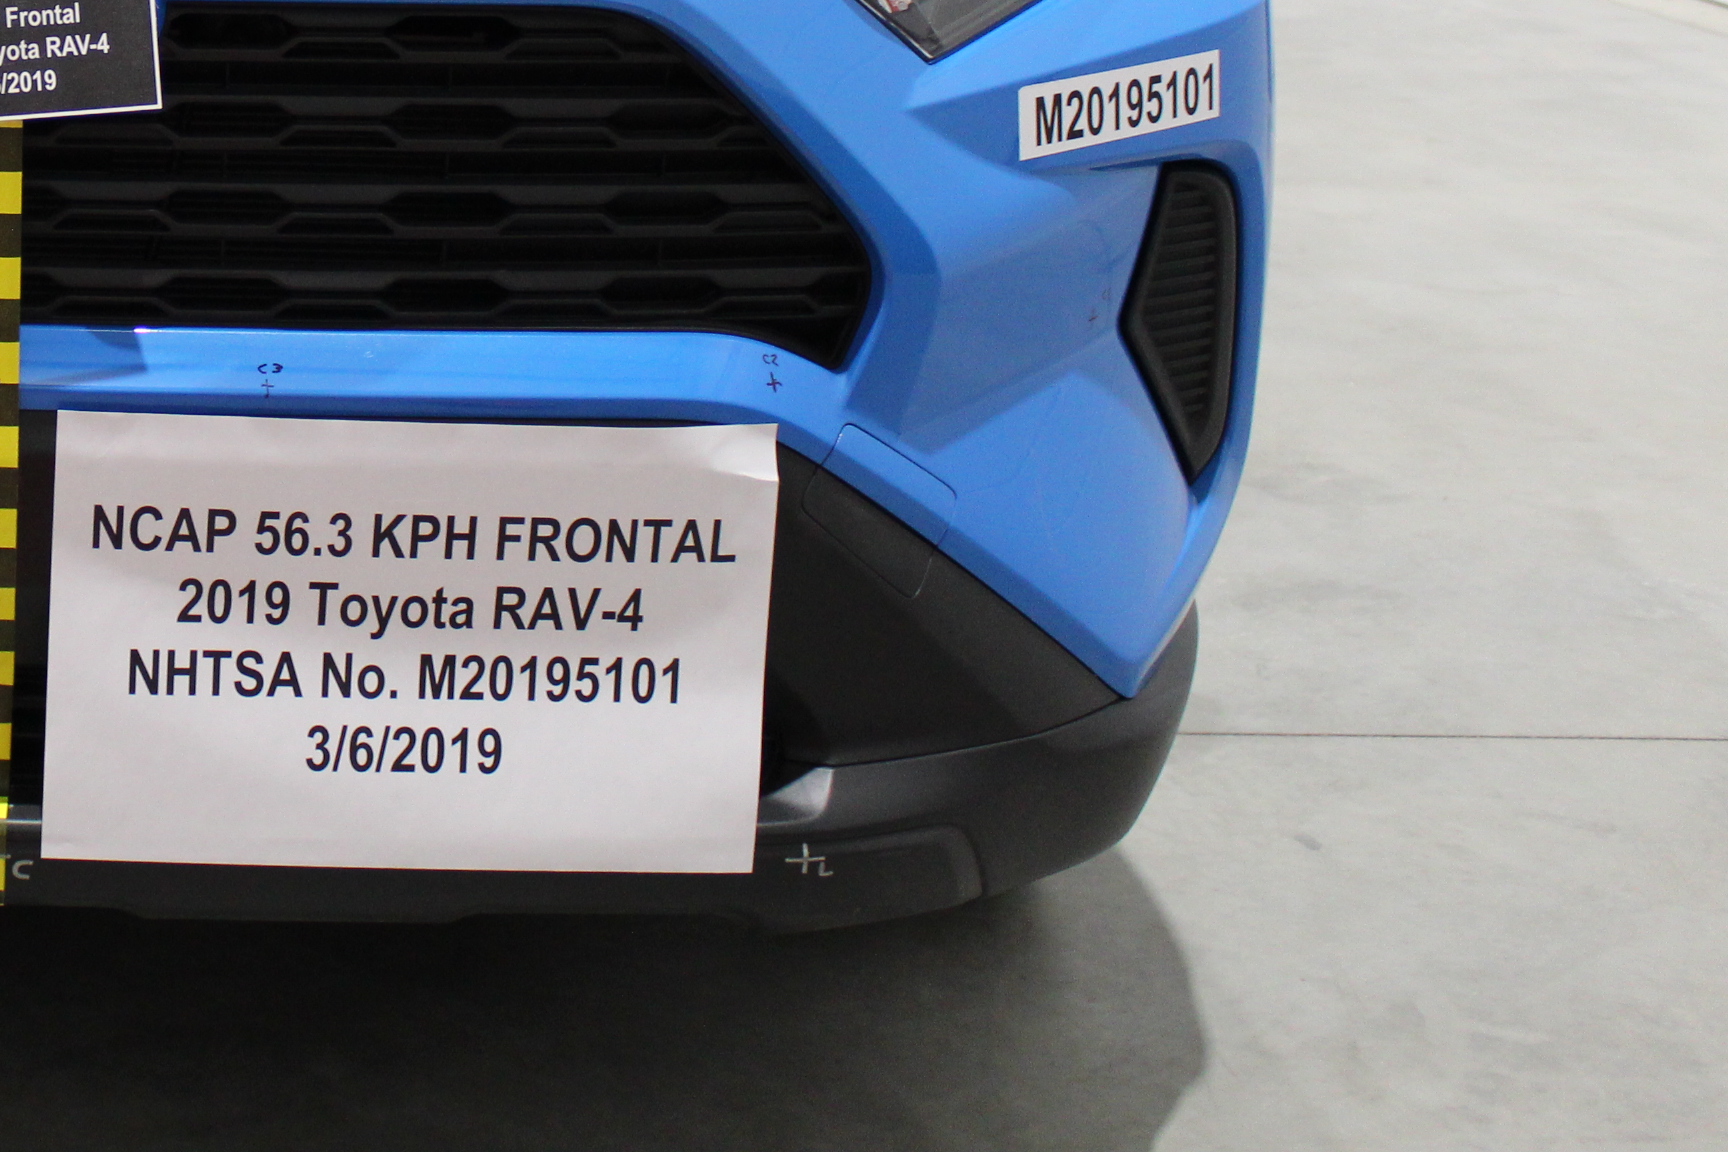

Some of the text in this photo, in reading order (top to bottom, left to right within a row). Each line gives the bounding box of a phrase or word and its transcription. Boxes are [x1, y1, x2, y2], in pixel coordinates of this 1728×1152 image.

[5, 2, 81, 28] Frontal
[46, 33, 110, 58] RAV-4
[1035, 63, 1213, 146] M20195101
[91, 504, 738, 565] NCAP 56.3 KPH FRONTAL
[176, 578, 645, 640] 2019 Toyota RAV-4
[127, 648, 682, 704] NHTSA No. M20195101
[305, 724, 503, 775] 3/6/2019
